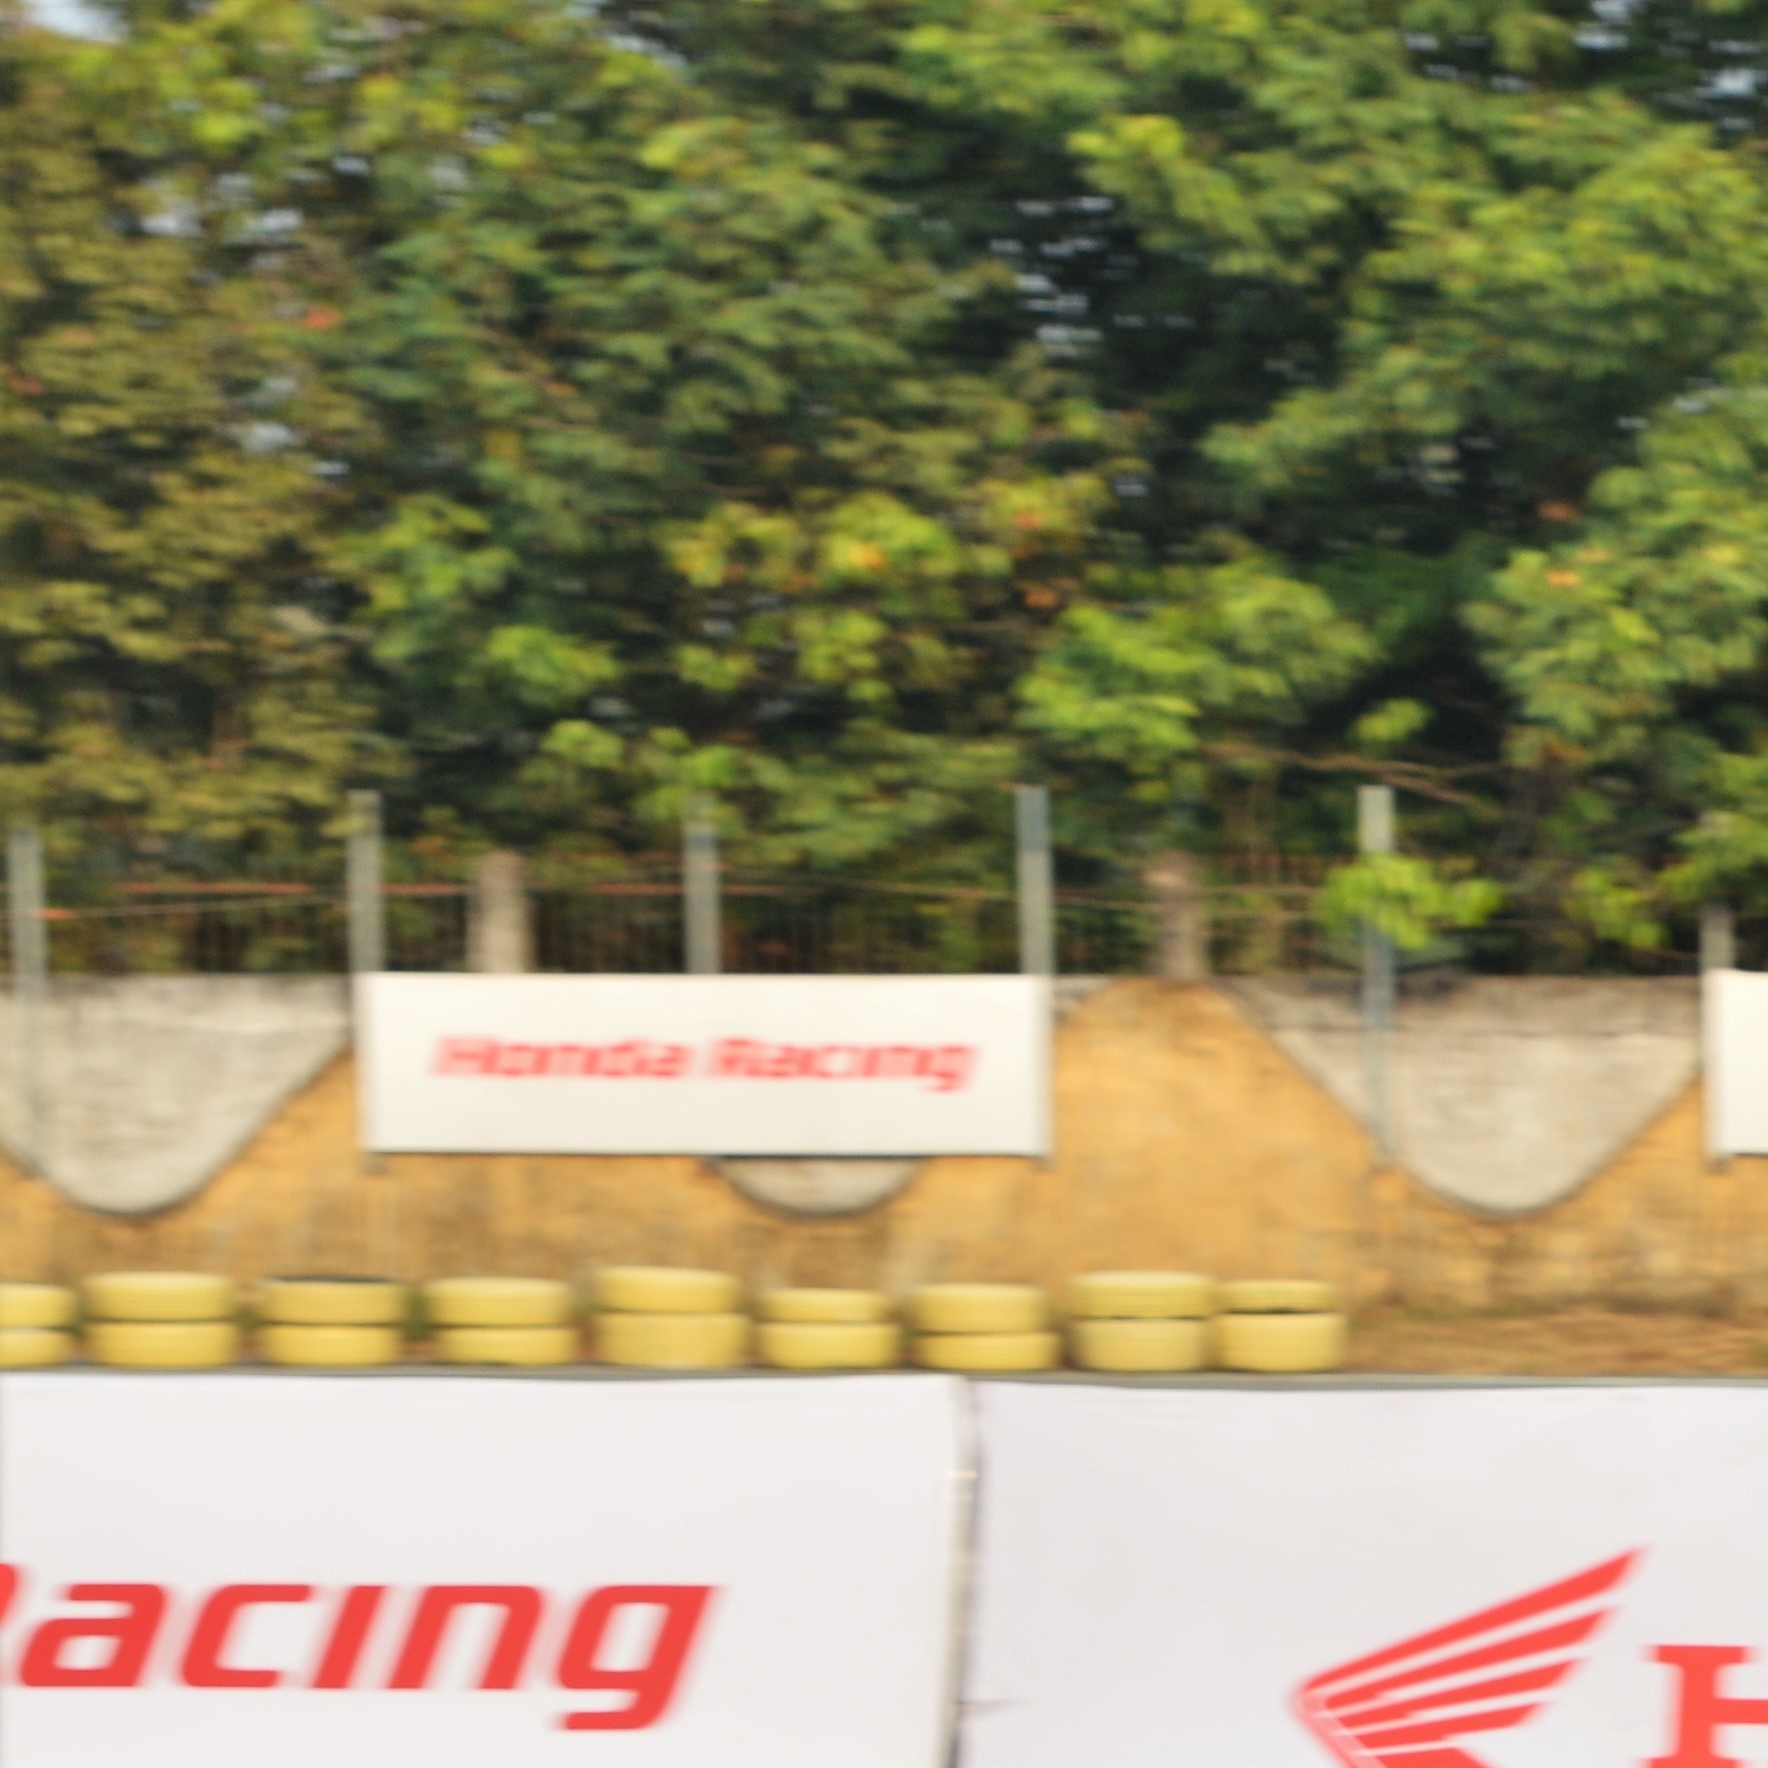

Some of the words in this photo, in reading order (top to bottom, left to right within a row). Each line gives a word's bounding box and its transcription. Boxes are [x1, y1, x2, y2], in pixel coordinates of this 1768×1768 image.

[434, 1037, 697, 1080] Honda
[706, 1037, 977, 1093] Racing
[0, 1561, 720, 1733] acing
